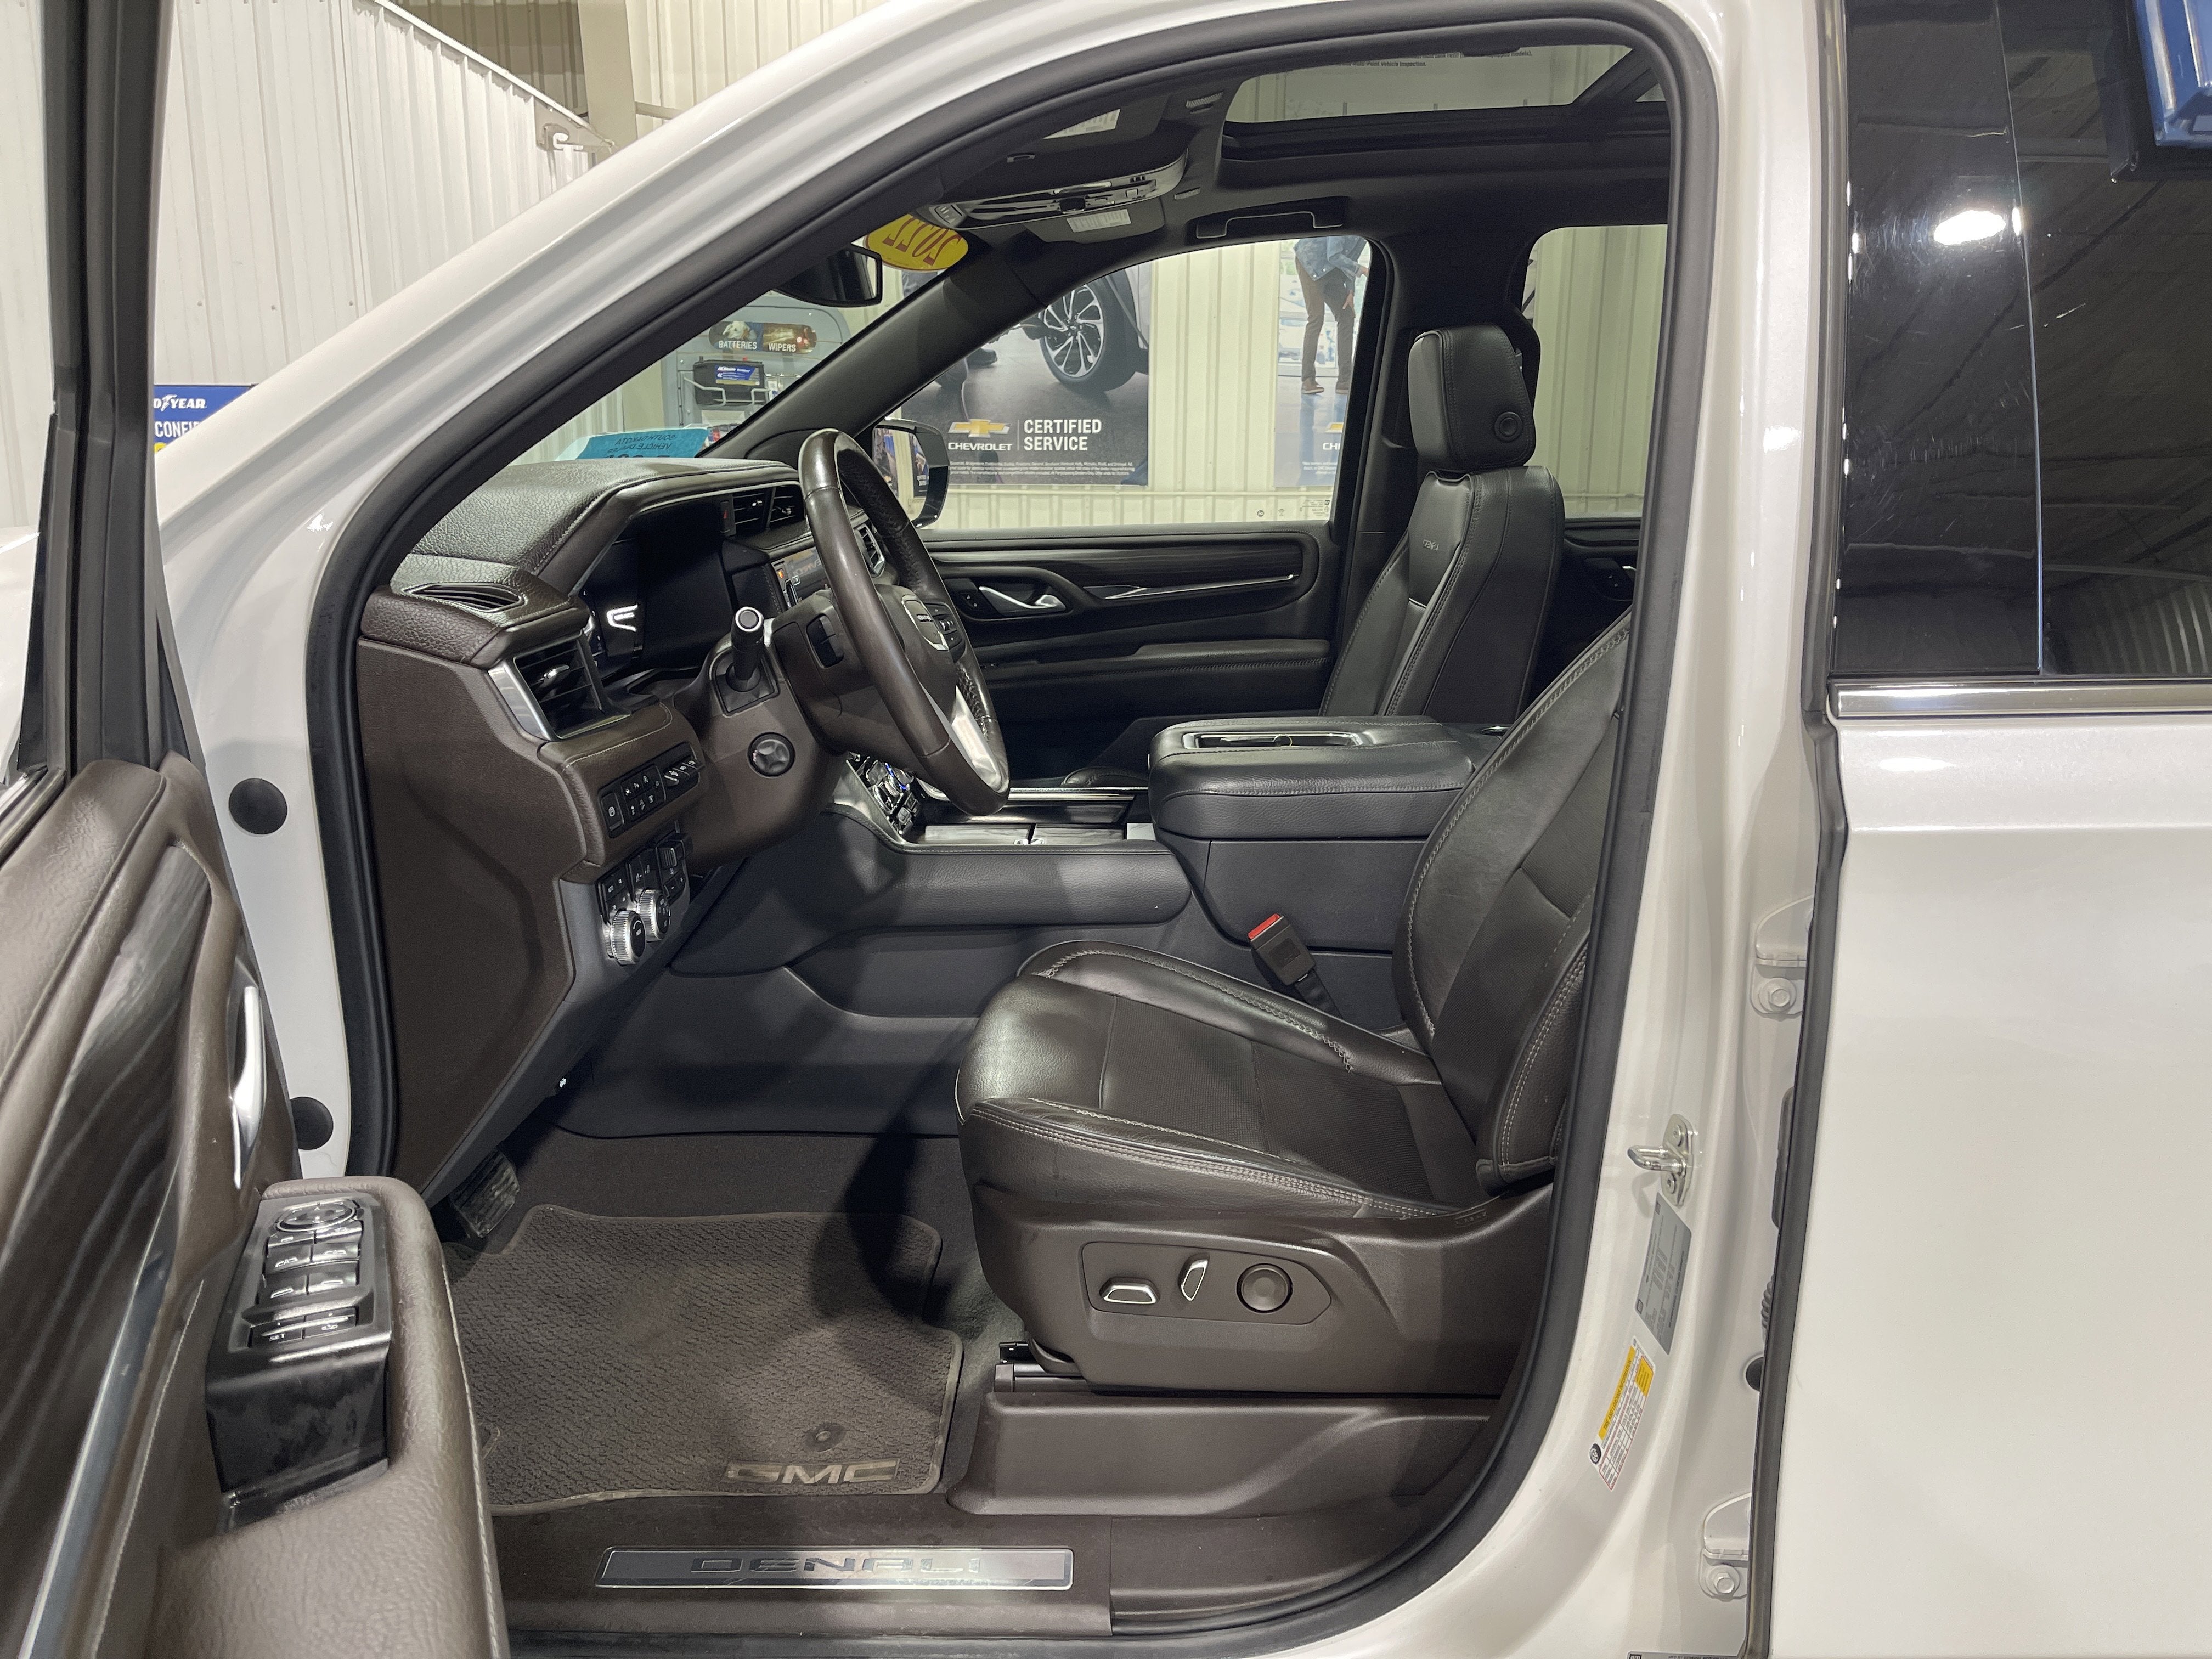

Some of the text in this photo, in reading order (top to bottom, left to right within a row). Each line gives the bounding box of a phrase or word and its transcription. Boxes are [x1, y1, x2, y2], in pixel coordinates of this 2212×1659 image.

[718, 340, 796, 352] BATTERIES WIPERS
[155, 421, 199, 437] CONFI
[1024, 419, 1102, 433] CERTIFIED
[947, 442, 1013, 451] CHEVROLET
[1024, 436, 1088, 451] SERVICE
[727, 1460, 896, 1484] GMC
[691, 1557, 981, 1573] DENALI
